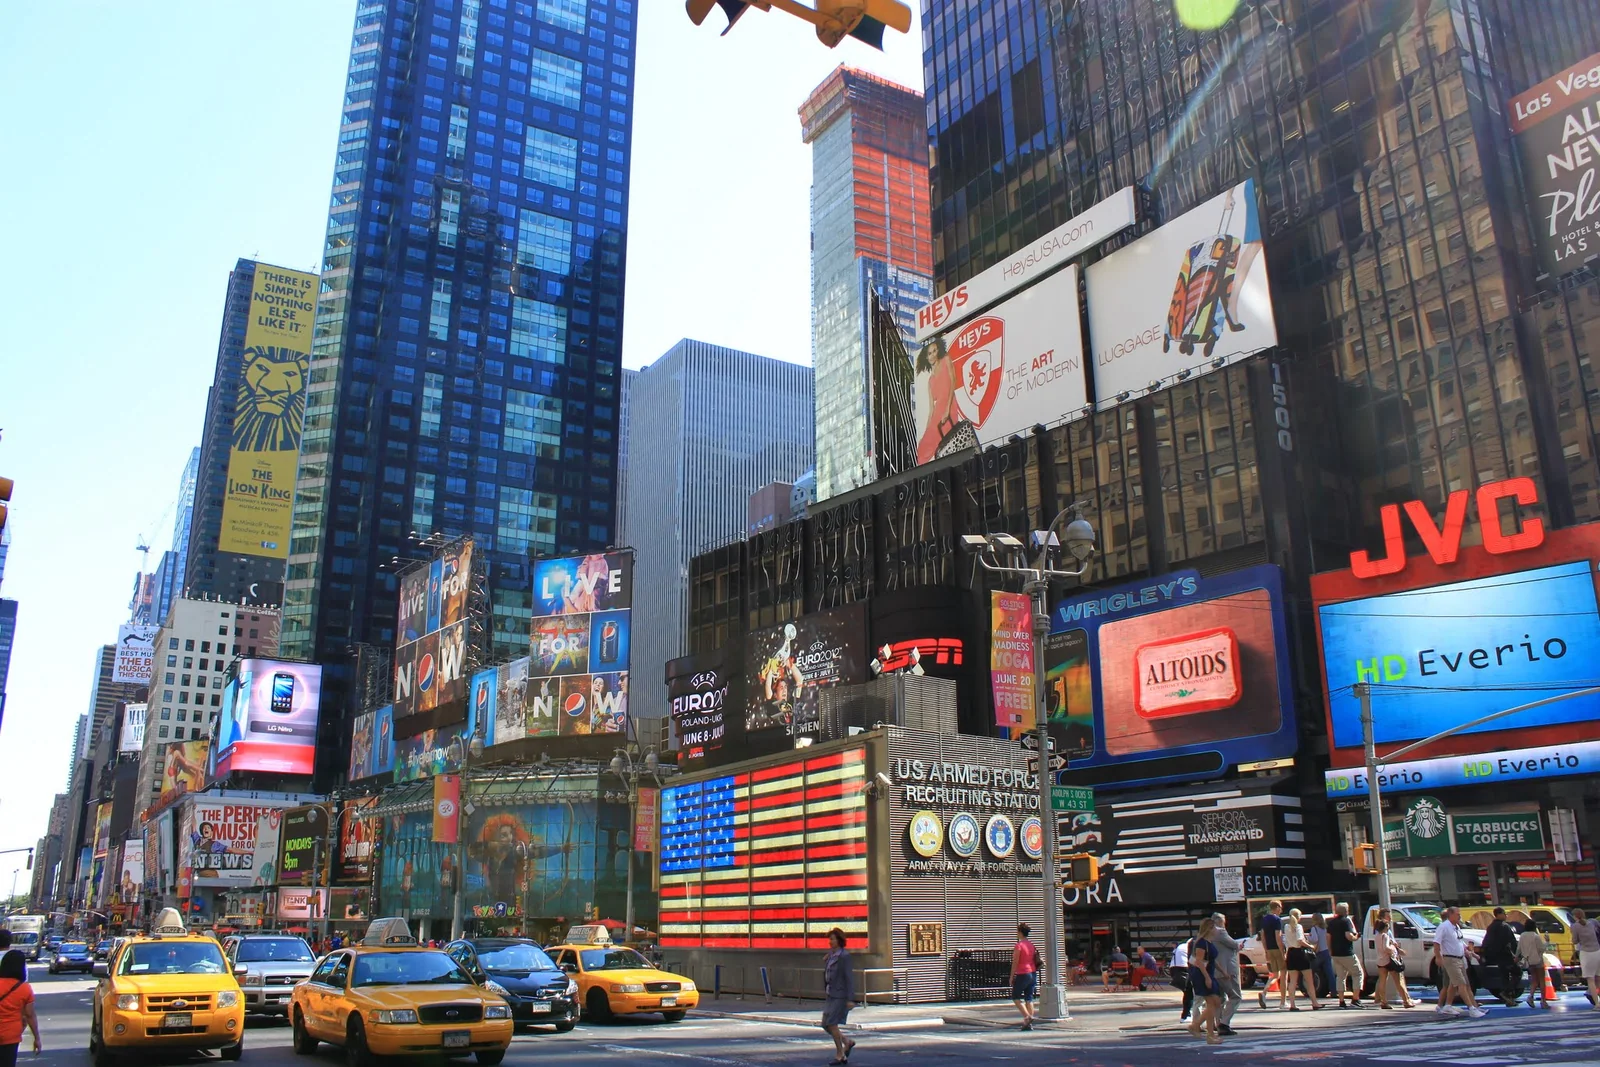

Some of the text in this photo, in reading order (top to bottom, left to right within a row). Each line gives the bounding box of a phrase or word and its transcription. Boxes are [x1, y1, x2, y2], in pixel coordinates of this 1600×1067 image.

[1515, 92, 1552, 122] Las
[1562, 225, 1592, 244] HOTEL
[1002, 218, 1094, 281] HeysUSA.com
[1554, 238, 1588, 262] LAS
[264, 283, 307, 299] SIMPLY
[301, 279, 312, 289] IS
[254, 292, 314, 312] NOTHING
[918, 286, 968, 328] HEYS
[269, 306, 296, 320] ELSE
[258, 316, 285, 330] LIKE
[958, 321, 991, 349] HEYS
[1098, 325, 1162, 366] LUGGAGE
[1005, 350, 1054, 383] THE ART
[1006, 356, 1079, 401] OF MODERN
[1272, 363, 1290, 450] 1500
[252, 468, 272, 480] THE
[1350, 476, 1545, 579] JVC
[442, 570, 468, 600] FOR
[542, 569, 622, 600] LIVE
[401, 592, 424, 621] LIVE
[1059, 576, 1198, 623] WRIGLEY'S
[993, 630, 1030, 640] MIND OVER
[540, 636, 580, 655] FOR
[993, 640, 1030, 652] MADNESS
[120, 657, 142, 666] THE
[994, 651, 1030, 670] YOGA
[1355, 634, 1567, 684] HD Everio
[820, 670, 831, 678] JULY
[1146, 650, 1228, 686] ALTOIDS
[996, 674, 1031, 686] JUNE 20
[996, 692, 1032, 710] FREE!
[682, 732, 702, 746] JUNE
[704, 730, 708, 742] 8
[1026, 738, 1036, 748] ONE
[1050, 758, 1062, 767] WAY
[1463, 752, 1580, 778] HD Everio
[897, 758, 924, 780] US
[930, 760, 990, 786] ARMED
[1326, 776, 1349, 792] HD
[906, 785, 991, 806] RECRUITING
[1052, 789, 1093, 800] ADOLPH OCHS ST
[1059, 800, 1087, 809] W 43 ST
[1202, 810, 1246, 825] SEPHORA
[1192, 819, 1258, 834] TIMES SQUARE
[1456, 820, 1538, 834] STARBUCKS
[232, 840, 246, 848] FOR
[286, 836, 312, 852] MONDAYS
[1188, 829, 1264, 844] TRANSFORMED
[1472, 831, 1525, 844] COFFEE
[284, 852, 298, 871] 9pm
[909, 860, 932, 870] ARMY
[941, 861, 962, 871] NAVY
[988, 862, 1014, 872] FORCE
[1246, 875, 1308, 892] SEPHORA
[472, 904, 494, 918] Toys
